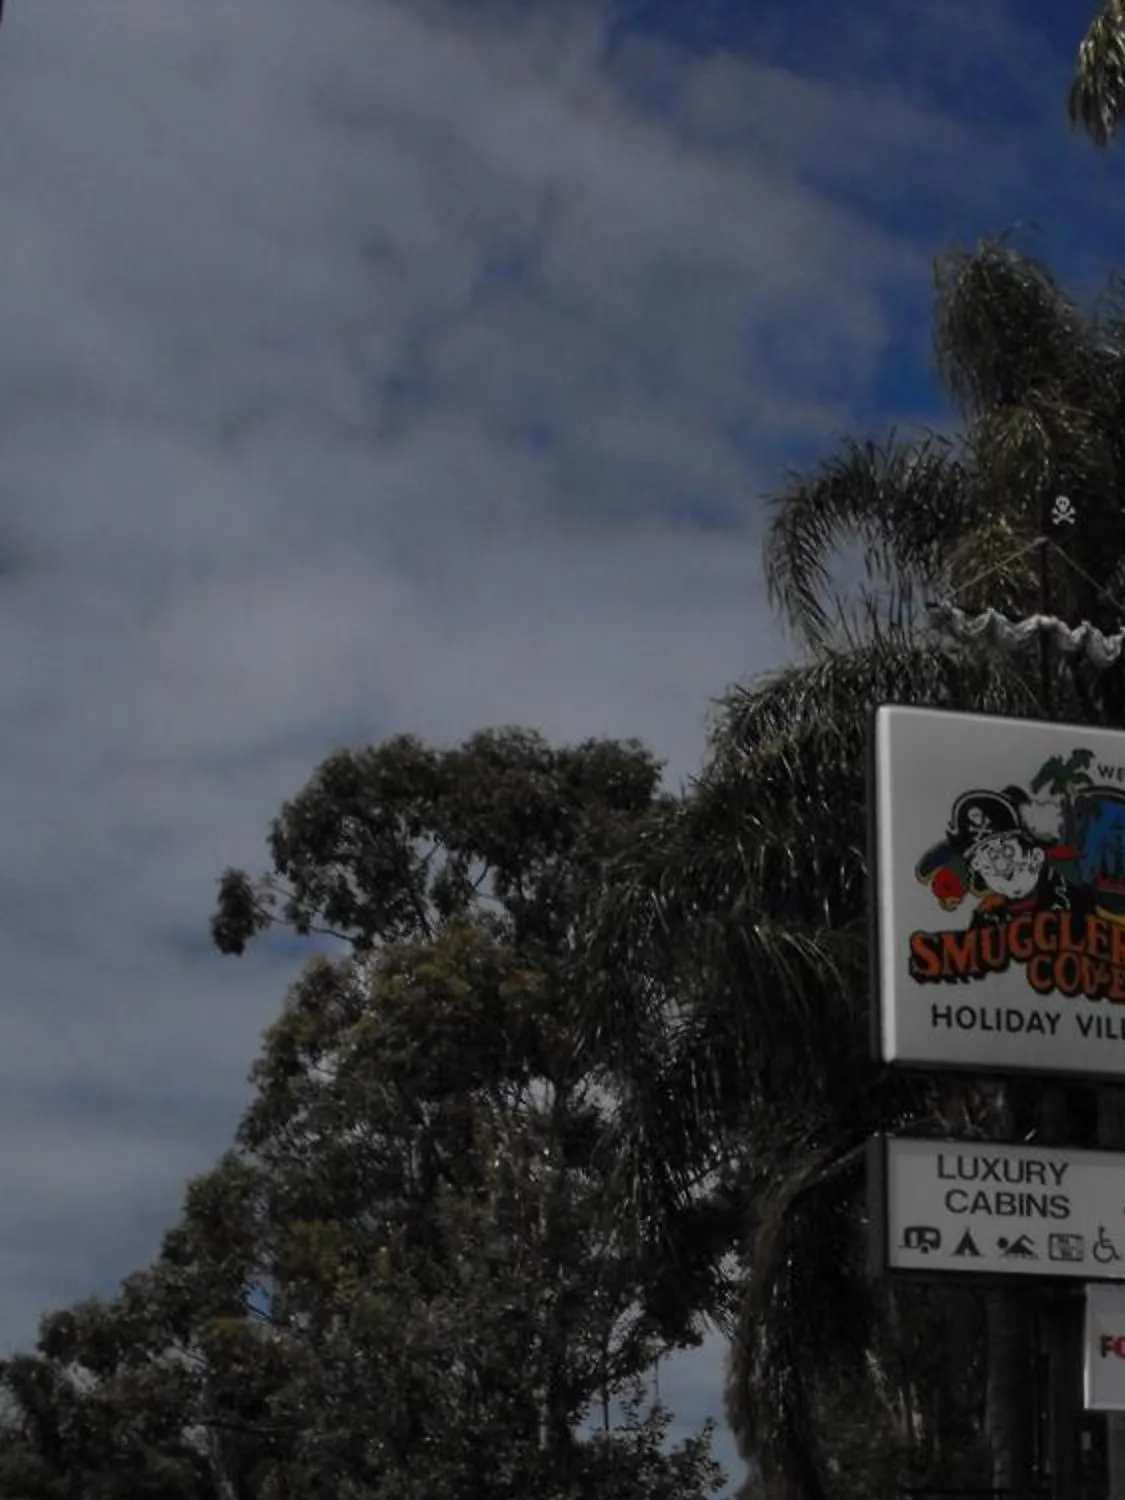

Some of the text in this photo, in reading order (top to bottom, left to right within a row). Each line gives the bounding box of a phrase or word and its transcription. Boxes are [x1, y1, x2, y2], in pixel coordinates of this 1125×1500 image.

[931, 1005, 1062, 1035] HOLIDAY
[937, 1153, 1069, 1186] LUXURY
[944, 1188, 1071, 1220] CABINS
